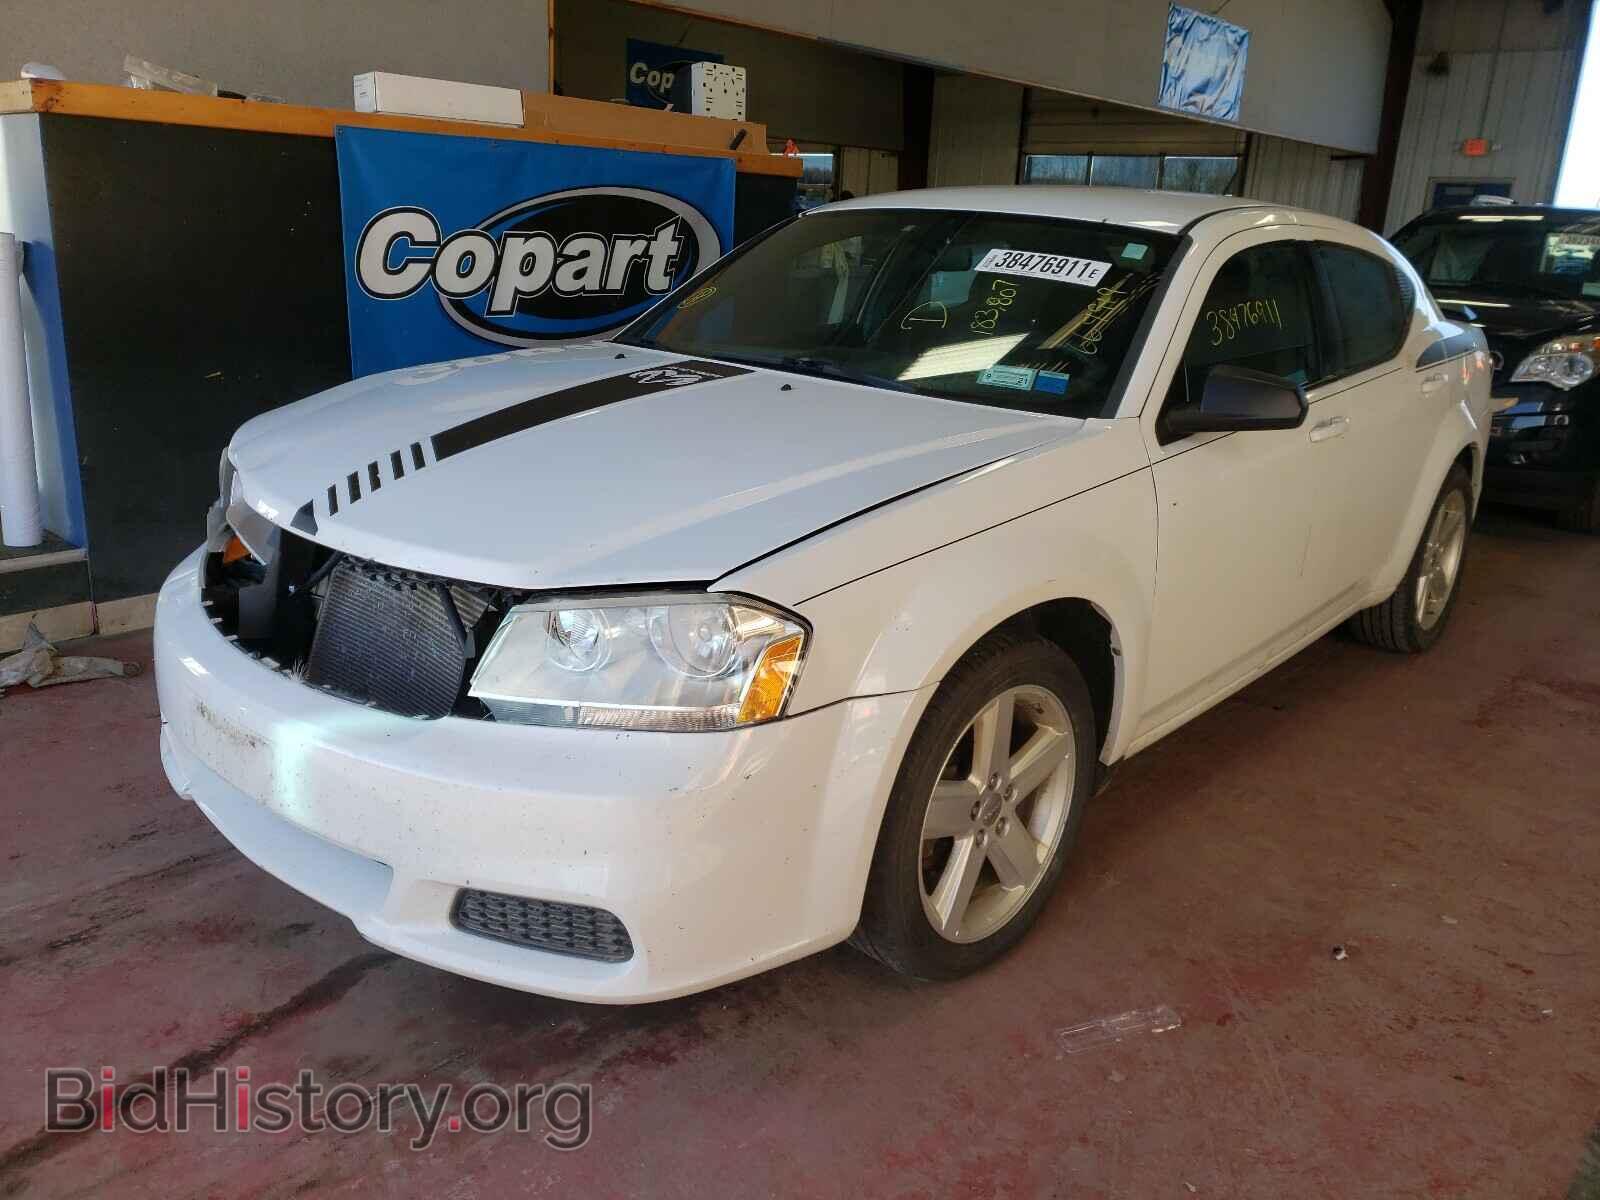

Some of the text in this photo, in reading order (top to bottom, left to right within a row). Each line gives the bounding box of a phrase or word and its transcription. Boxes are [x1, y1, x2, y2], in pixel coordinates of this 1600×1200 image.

[355, 206, 685, 317] Copart
[995, 251, 1092, 279] 38476911
[1206, 297, 1283, 346] 38476911
